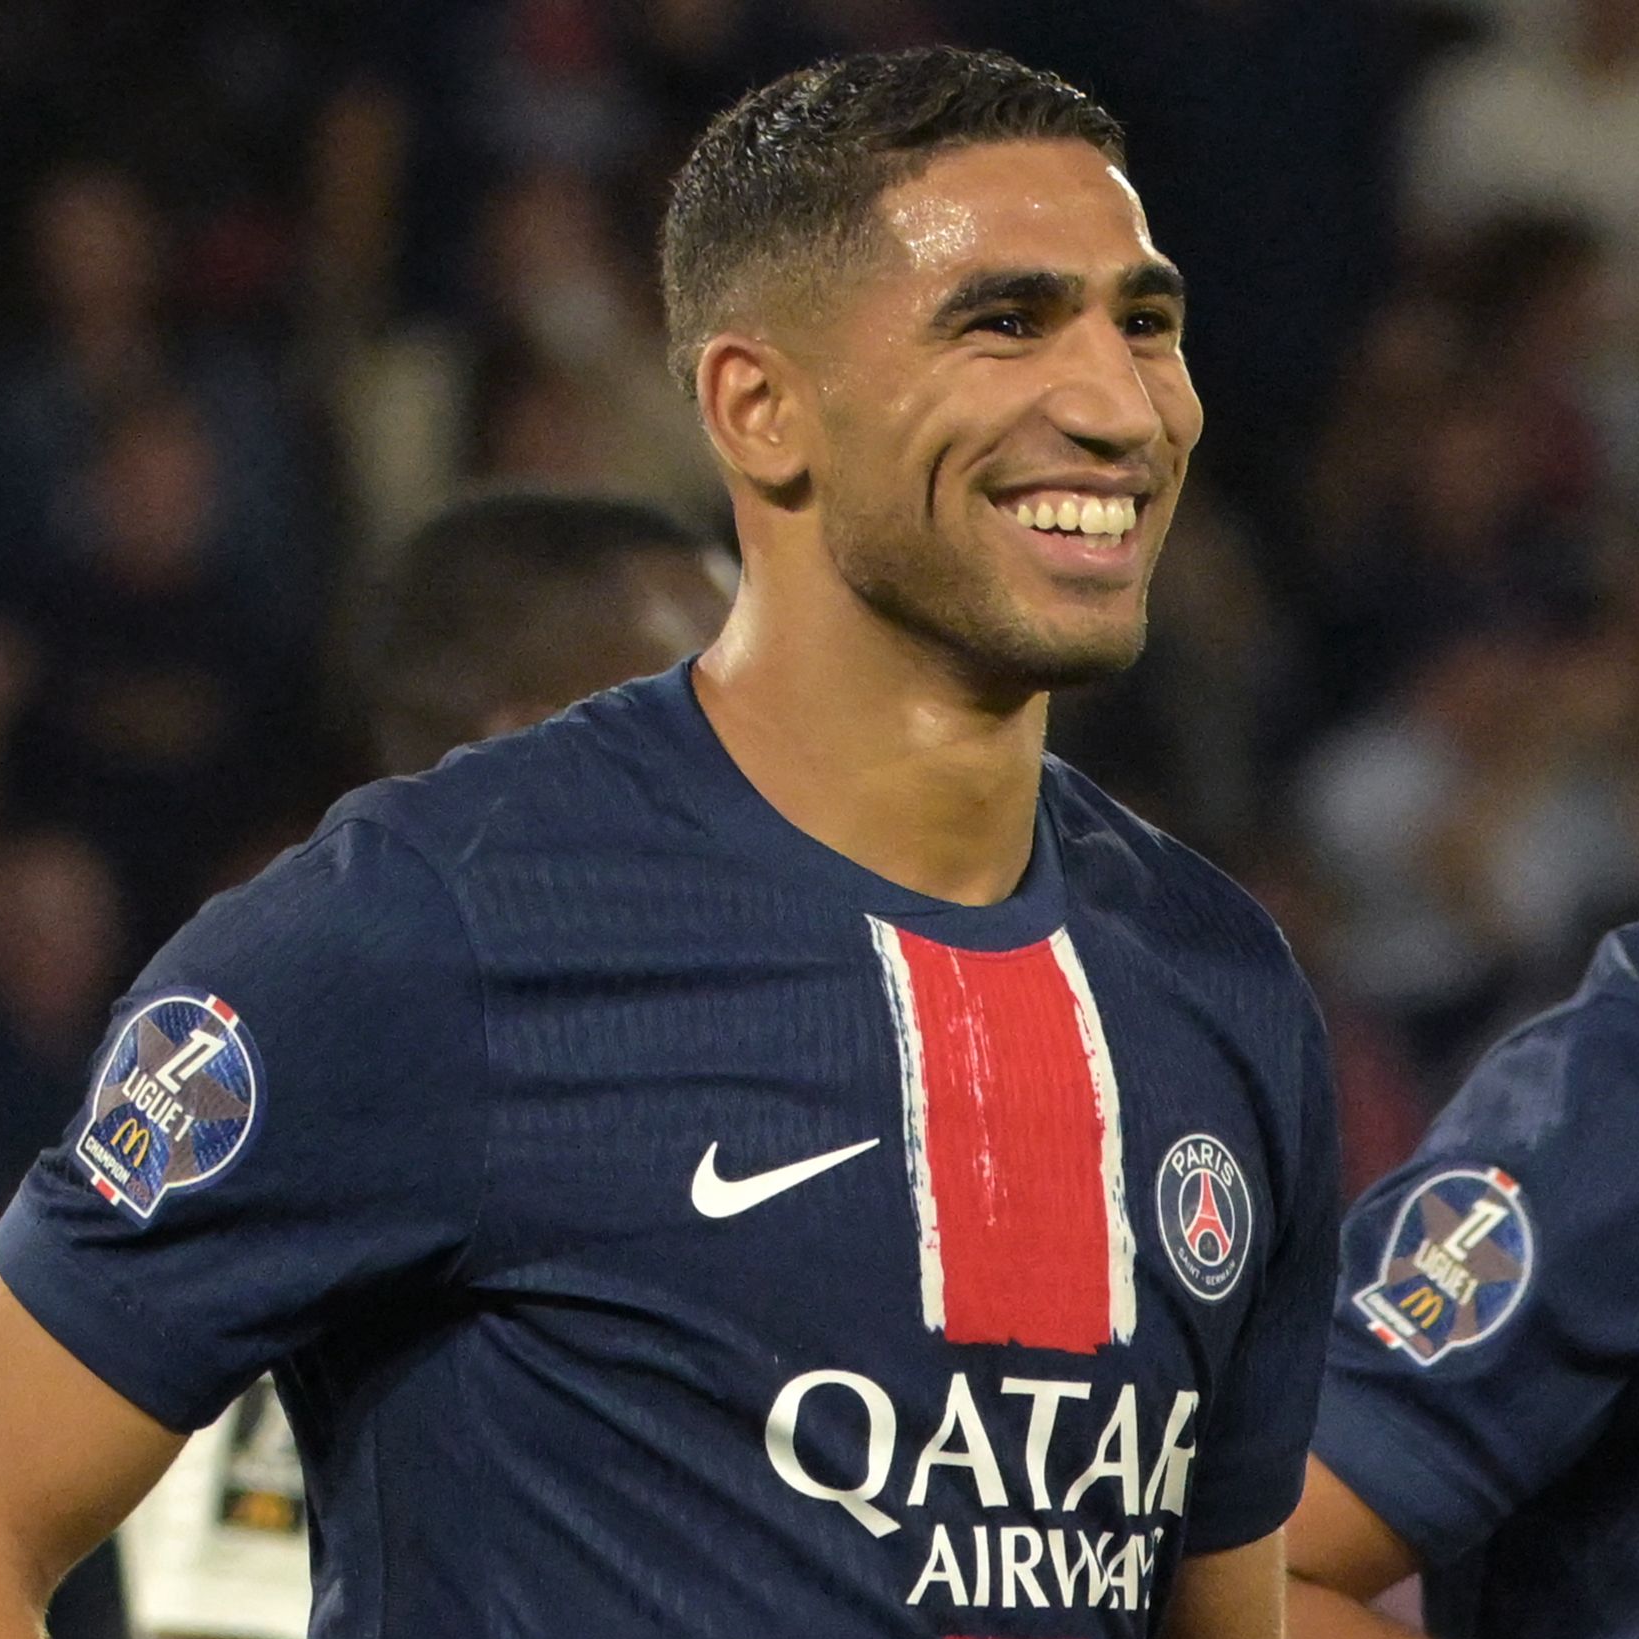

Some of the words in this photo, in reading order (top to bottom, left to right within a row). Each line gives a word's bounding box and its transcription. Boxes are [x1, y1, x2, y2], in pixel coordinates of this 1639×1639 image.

[121, 1066, 183, 1134] LIGUE
[174, 1113, 195, 1142] 1
[84, 1135, 131, 1185] CHAMPION
[1171, 1142, 1235, 1187] PARIS
[765, 1369, 1199, 1538] QATAR
